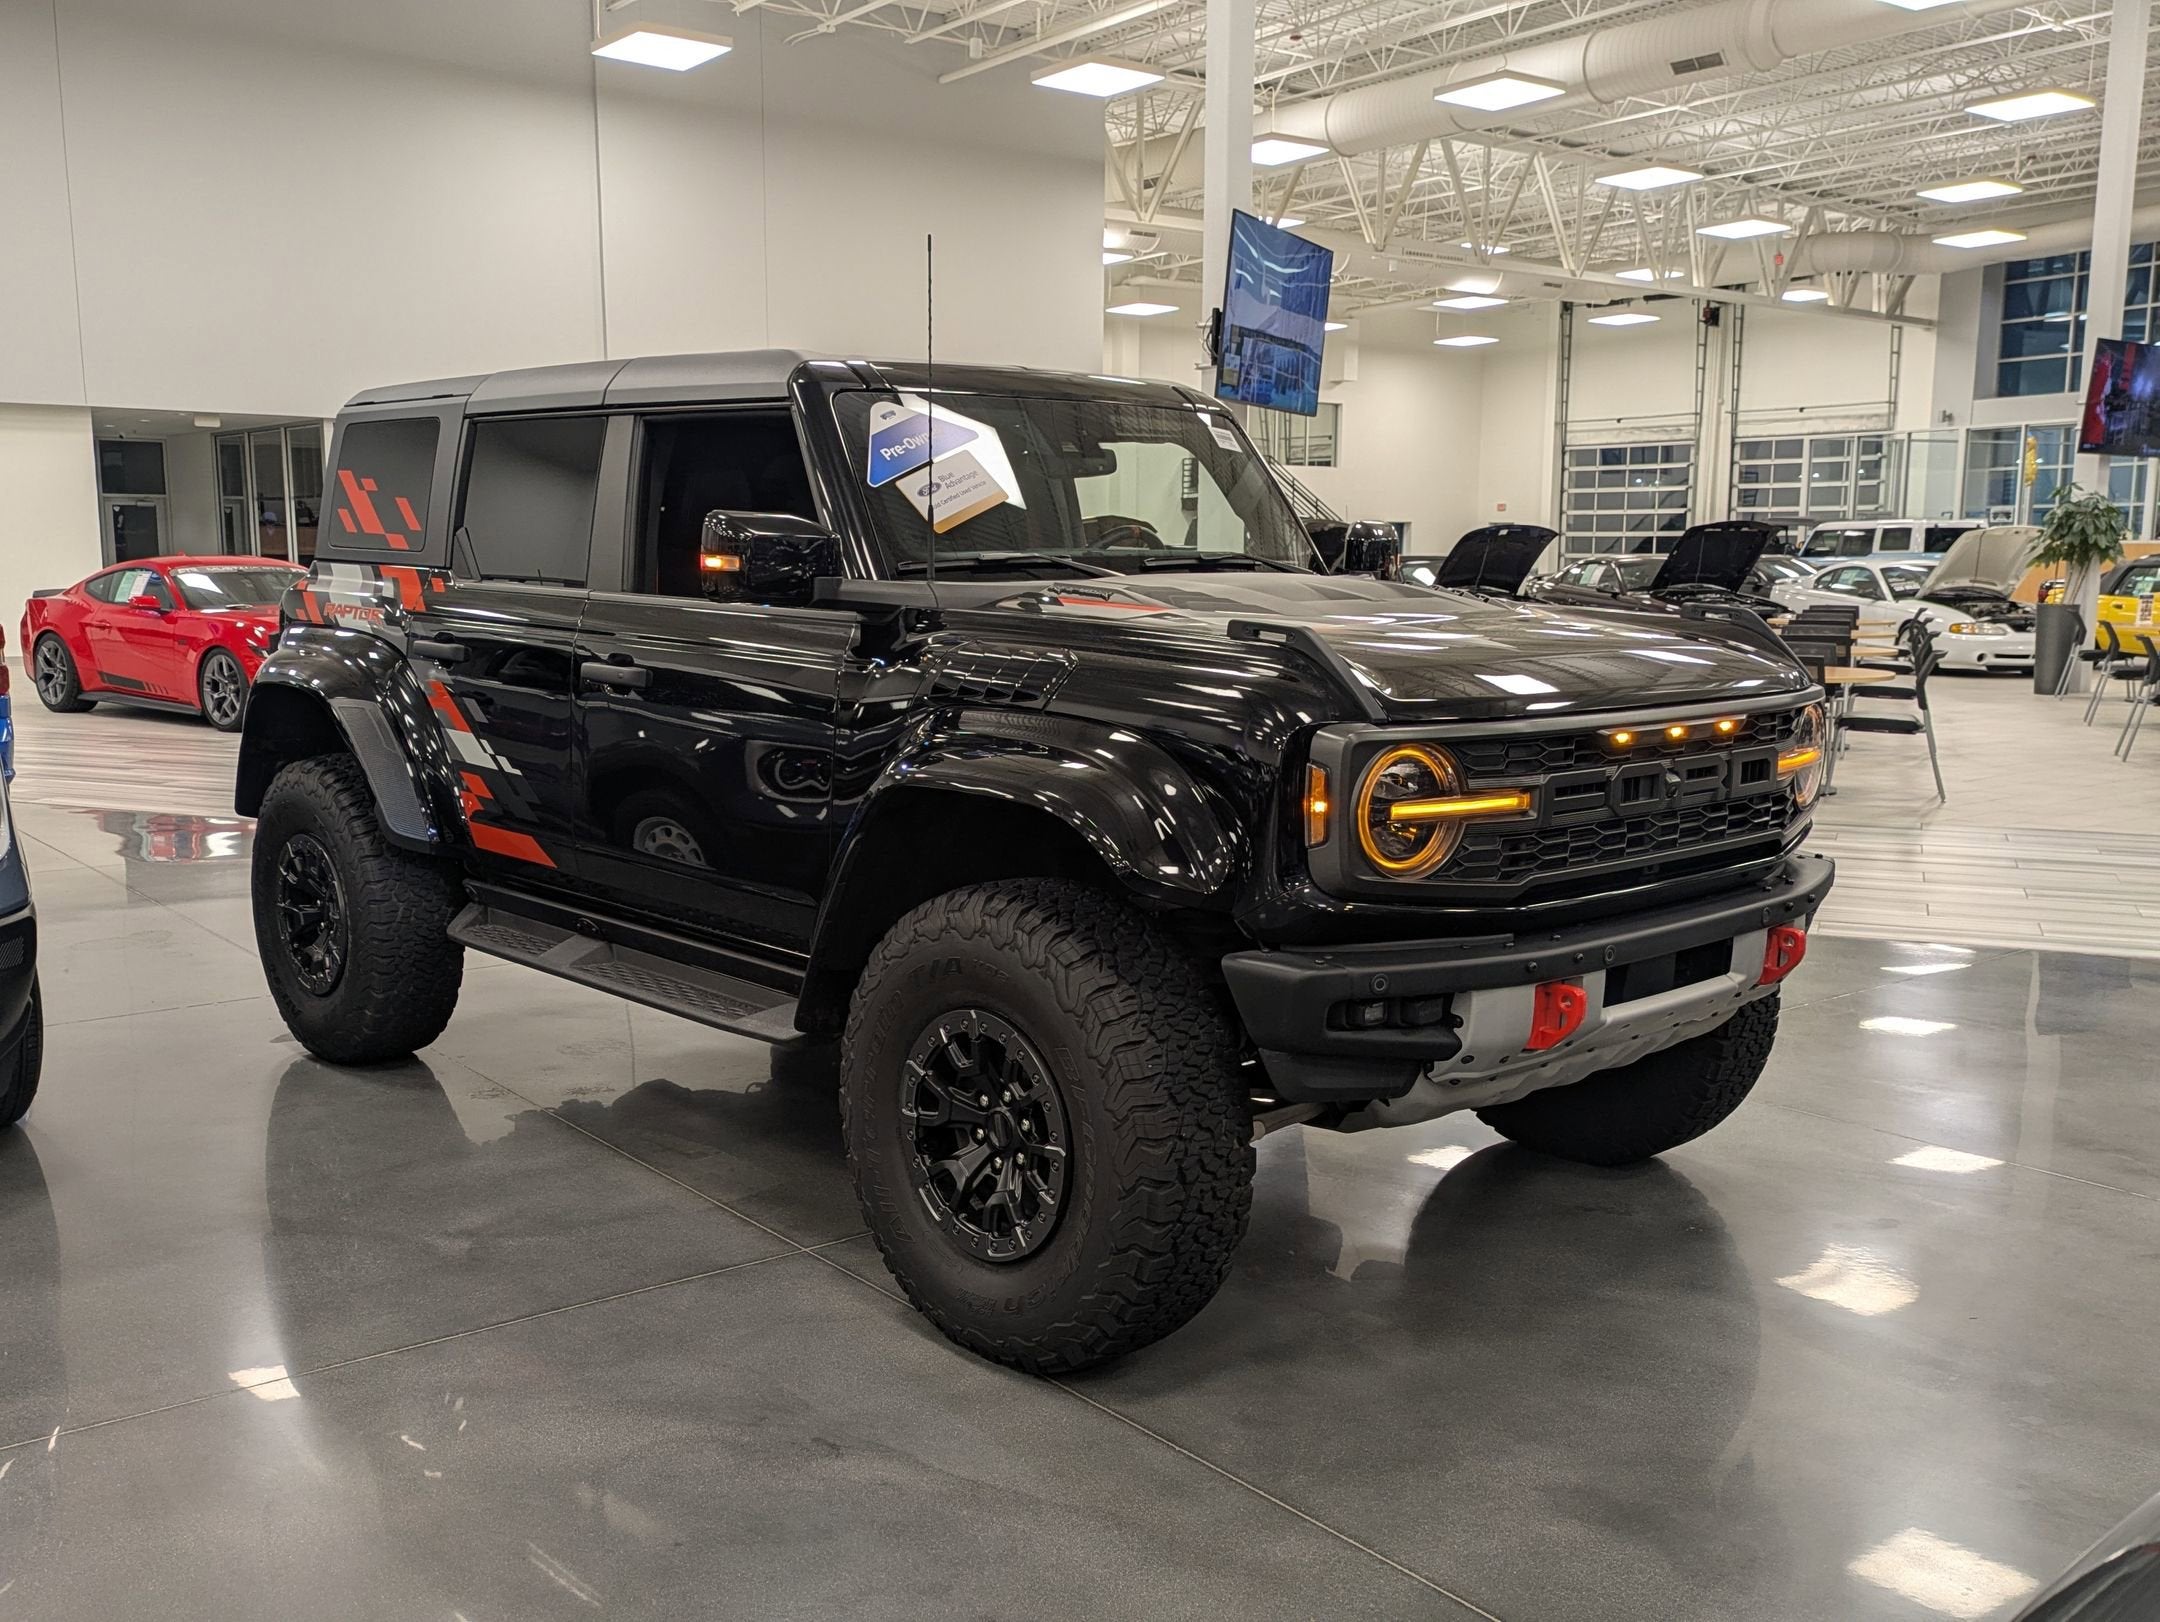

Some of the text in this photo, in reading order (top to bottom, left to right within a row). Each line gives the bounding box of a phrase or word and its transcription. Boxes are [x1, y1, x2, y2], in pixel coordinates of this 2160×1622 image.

[938, 472, 955, 483] Blue
[944, 470, 979, 489] Advantage
[323, 602, 385, 628] RAPTOR
[1541, 747, 1778, 828] FORD
